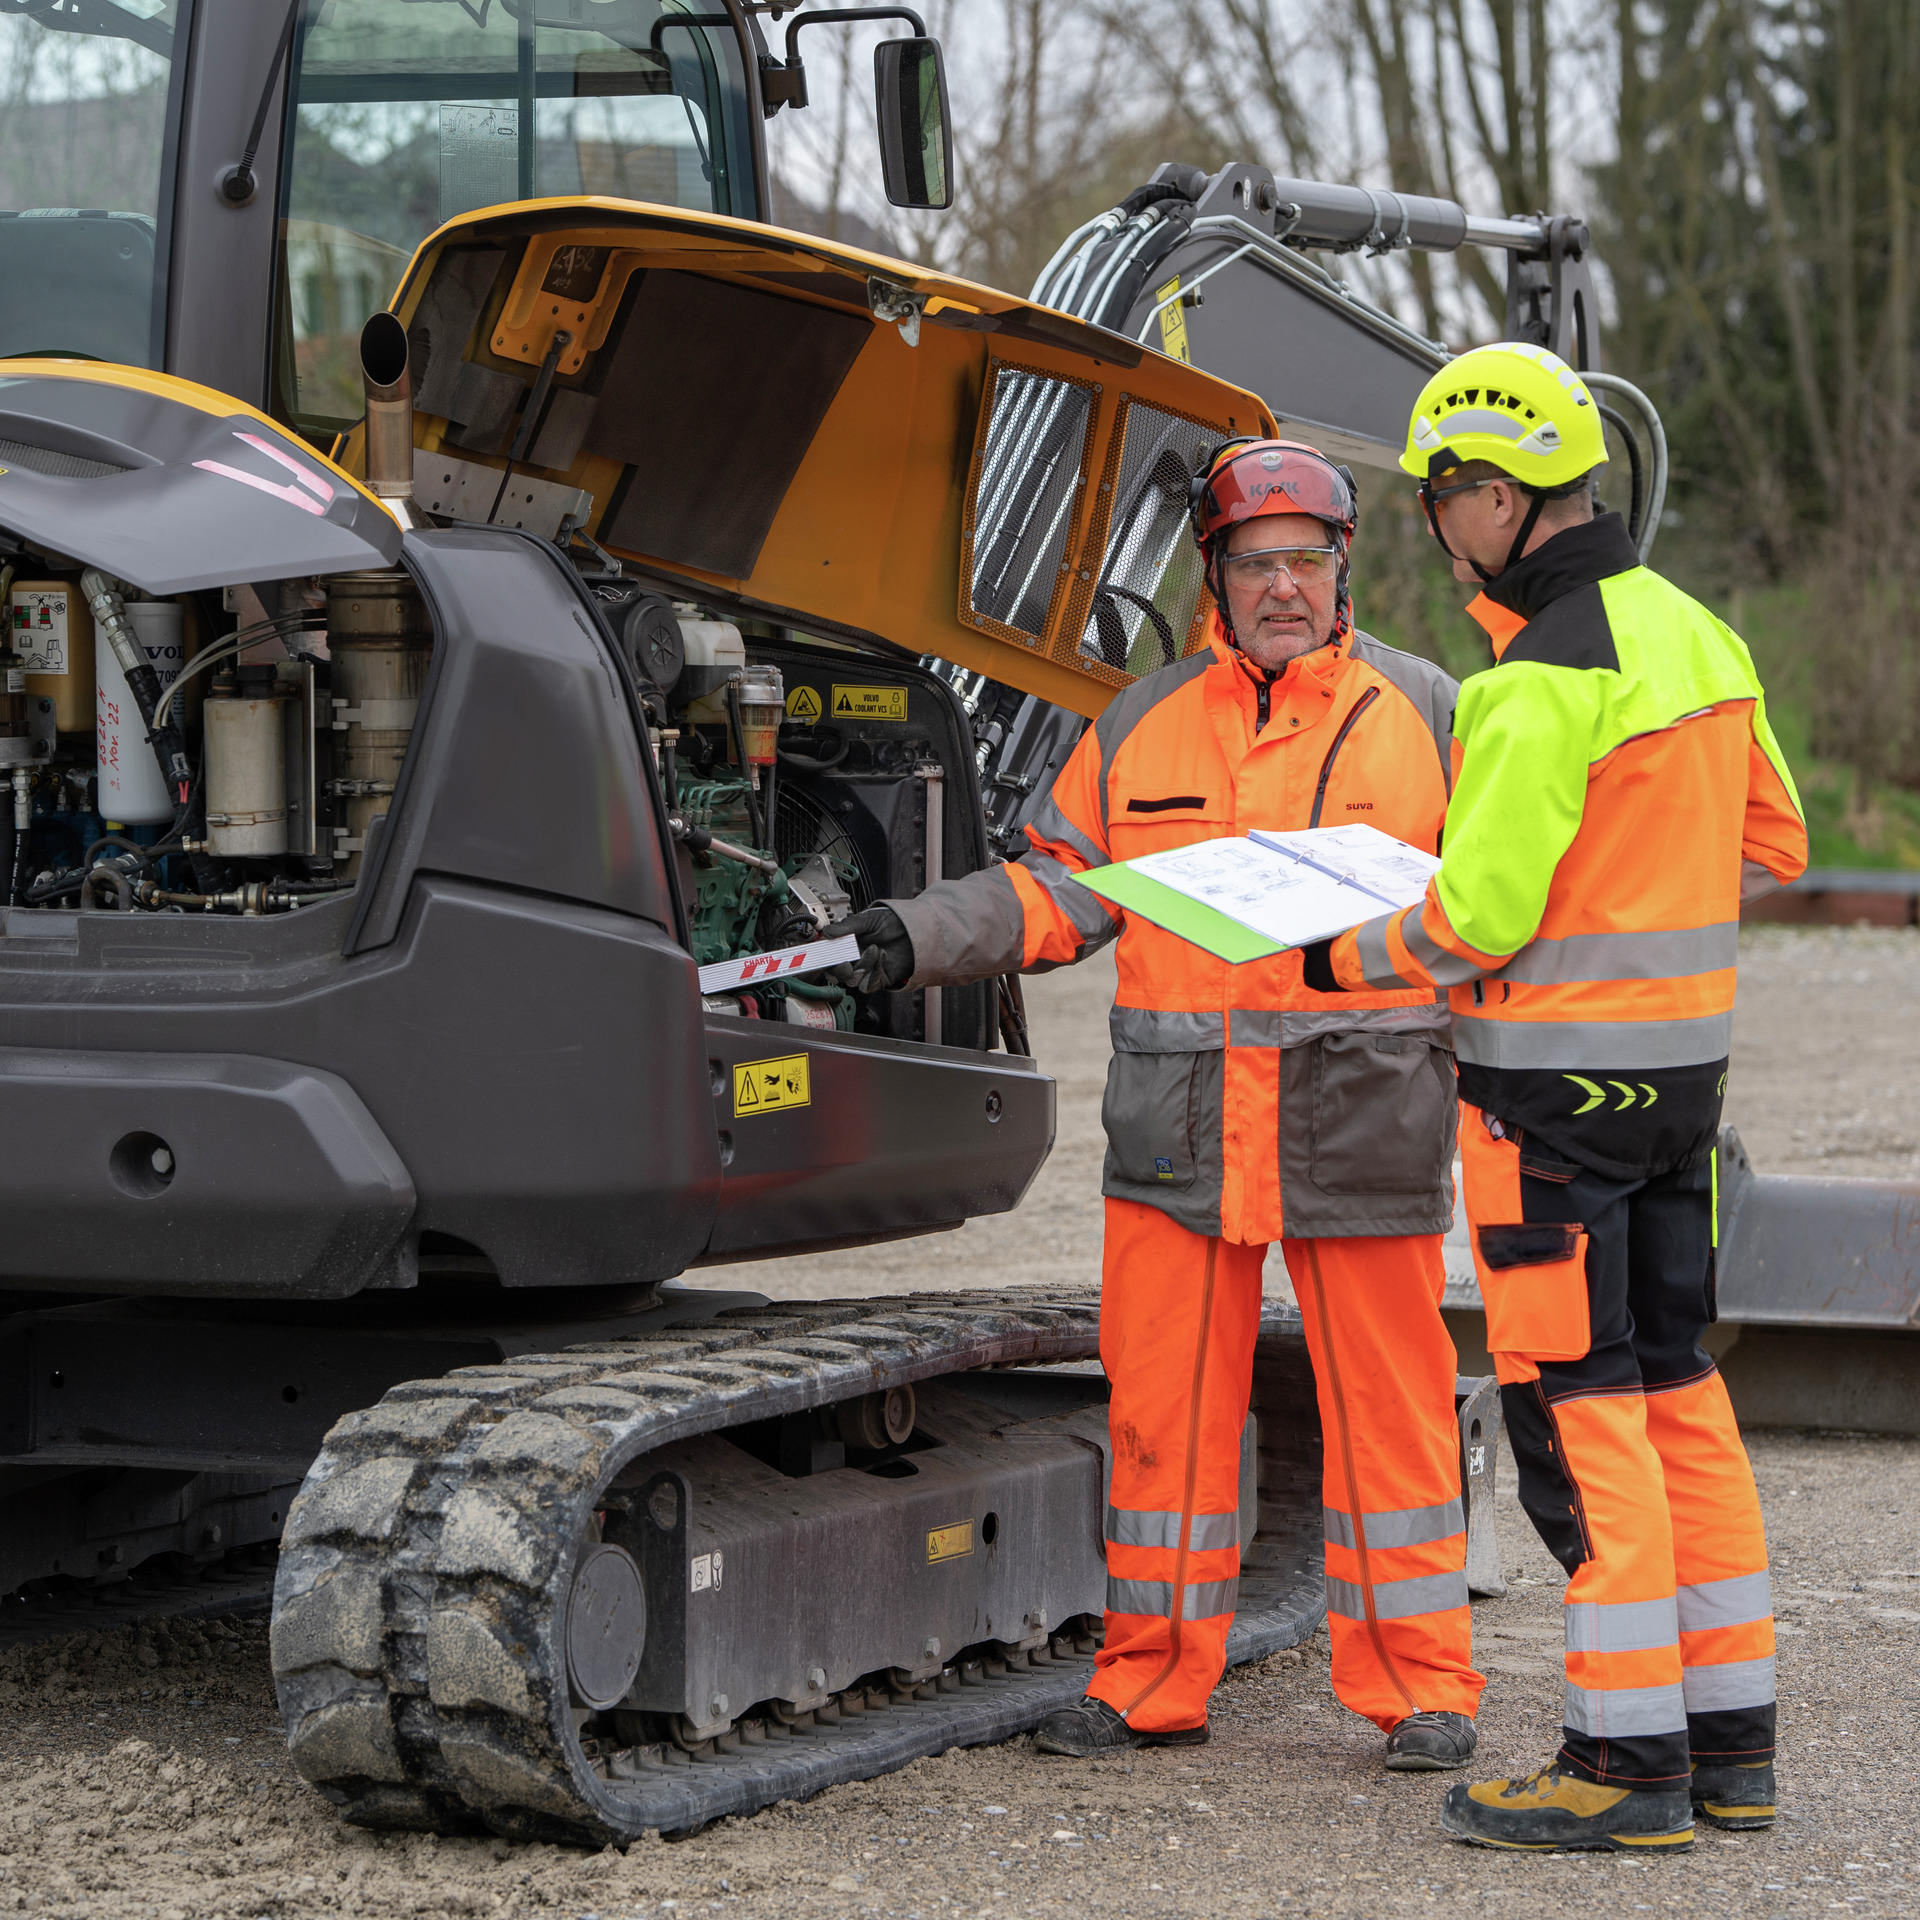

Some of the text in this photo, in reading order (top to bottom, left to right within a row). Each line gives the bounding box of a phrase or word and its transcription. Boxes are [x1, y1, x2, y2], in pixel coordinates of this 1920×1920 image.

[1250, 481, 1299, 497] KAK
[863, 694, 879, 702] VOLVO
[854, 704, 887, 713] COOLANT VCS
[1346, 802, 1373, 810] suva
